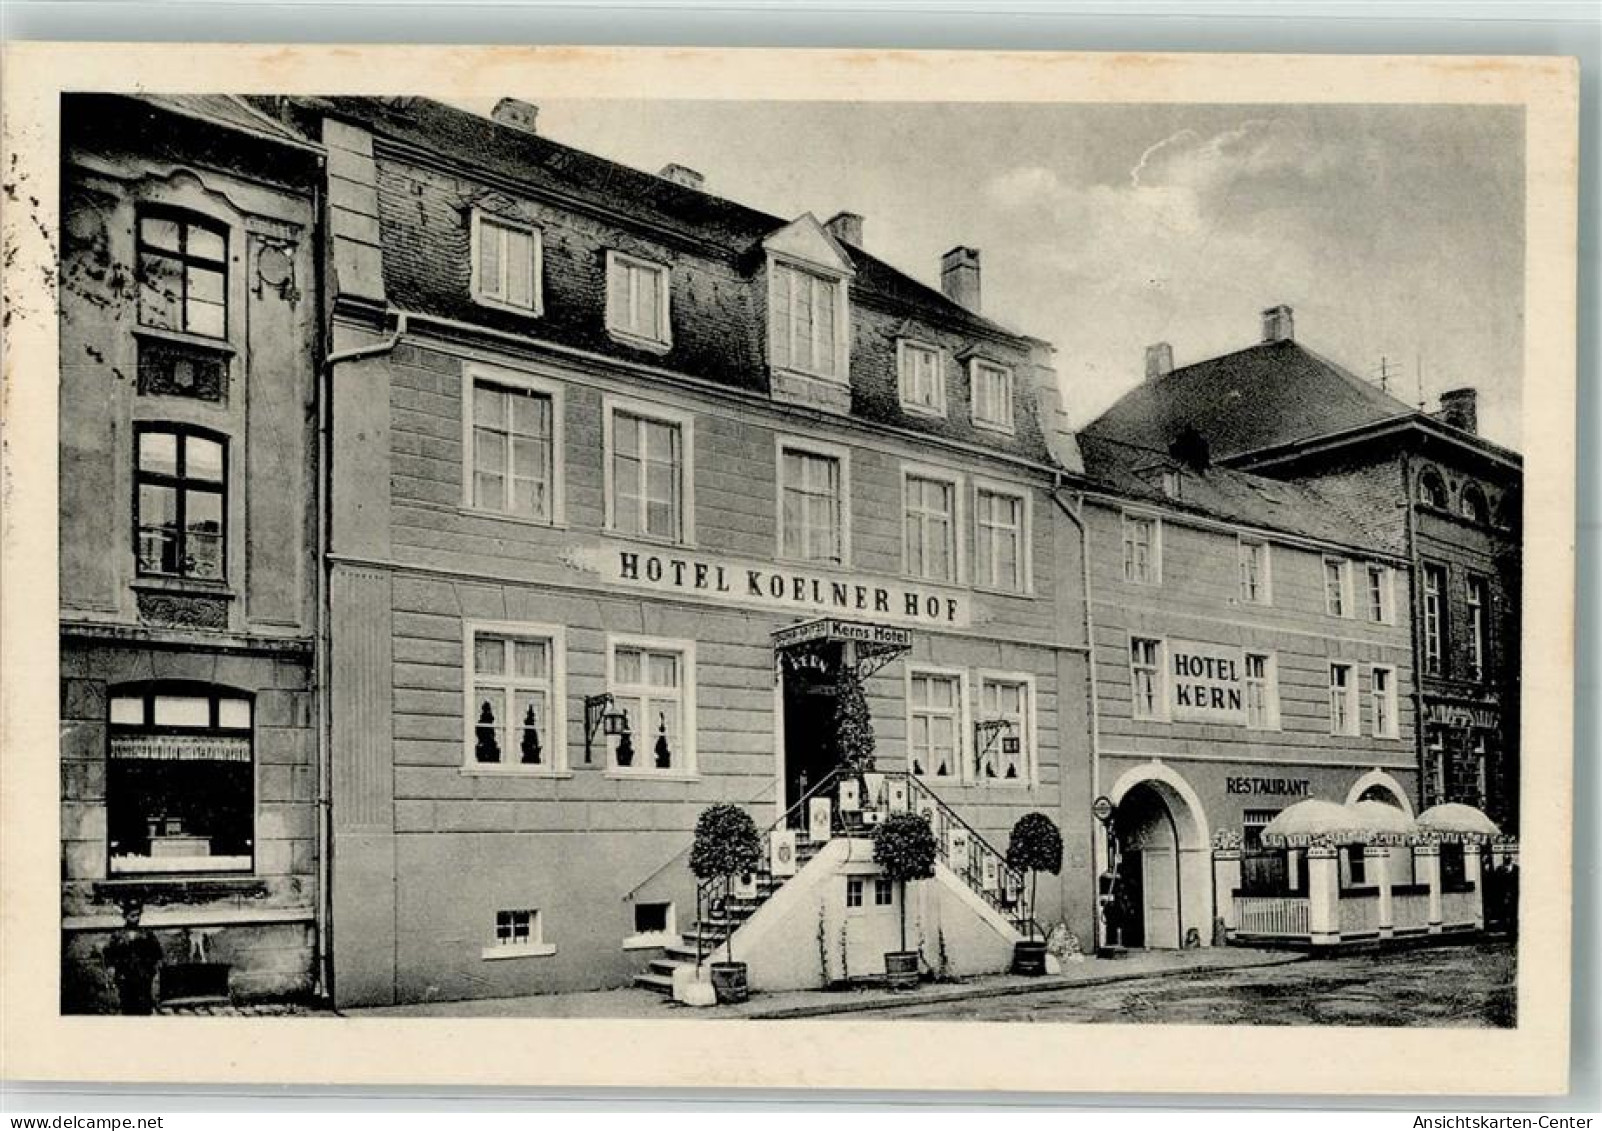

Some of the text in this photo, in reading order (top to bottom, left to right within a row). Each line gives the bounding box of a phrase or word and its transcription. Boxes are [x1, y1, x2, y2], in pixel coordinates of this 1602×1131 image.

[619, 552, 958, 621] HOTEL KOELNER HOF
[832, 621, 871, 638] Kerns
[874, 627, 909, 643] Hotel
[1174, 653, 1240, 682] HOTEL
[1176, 684, 1241, 710] KERN
[1225, 776, 1310, 796] RESTAURANT
